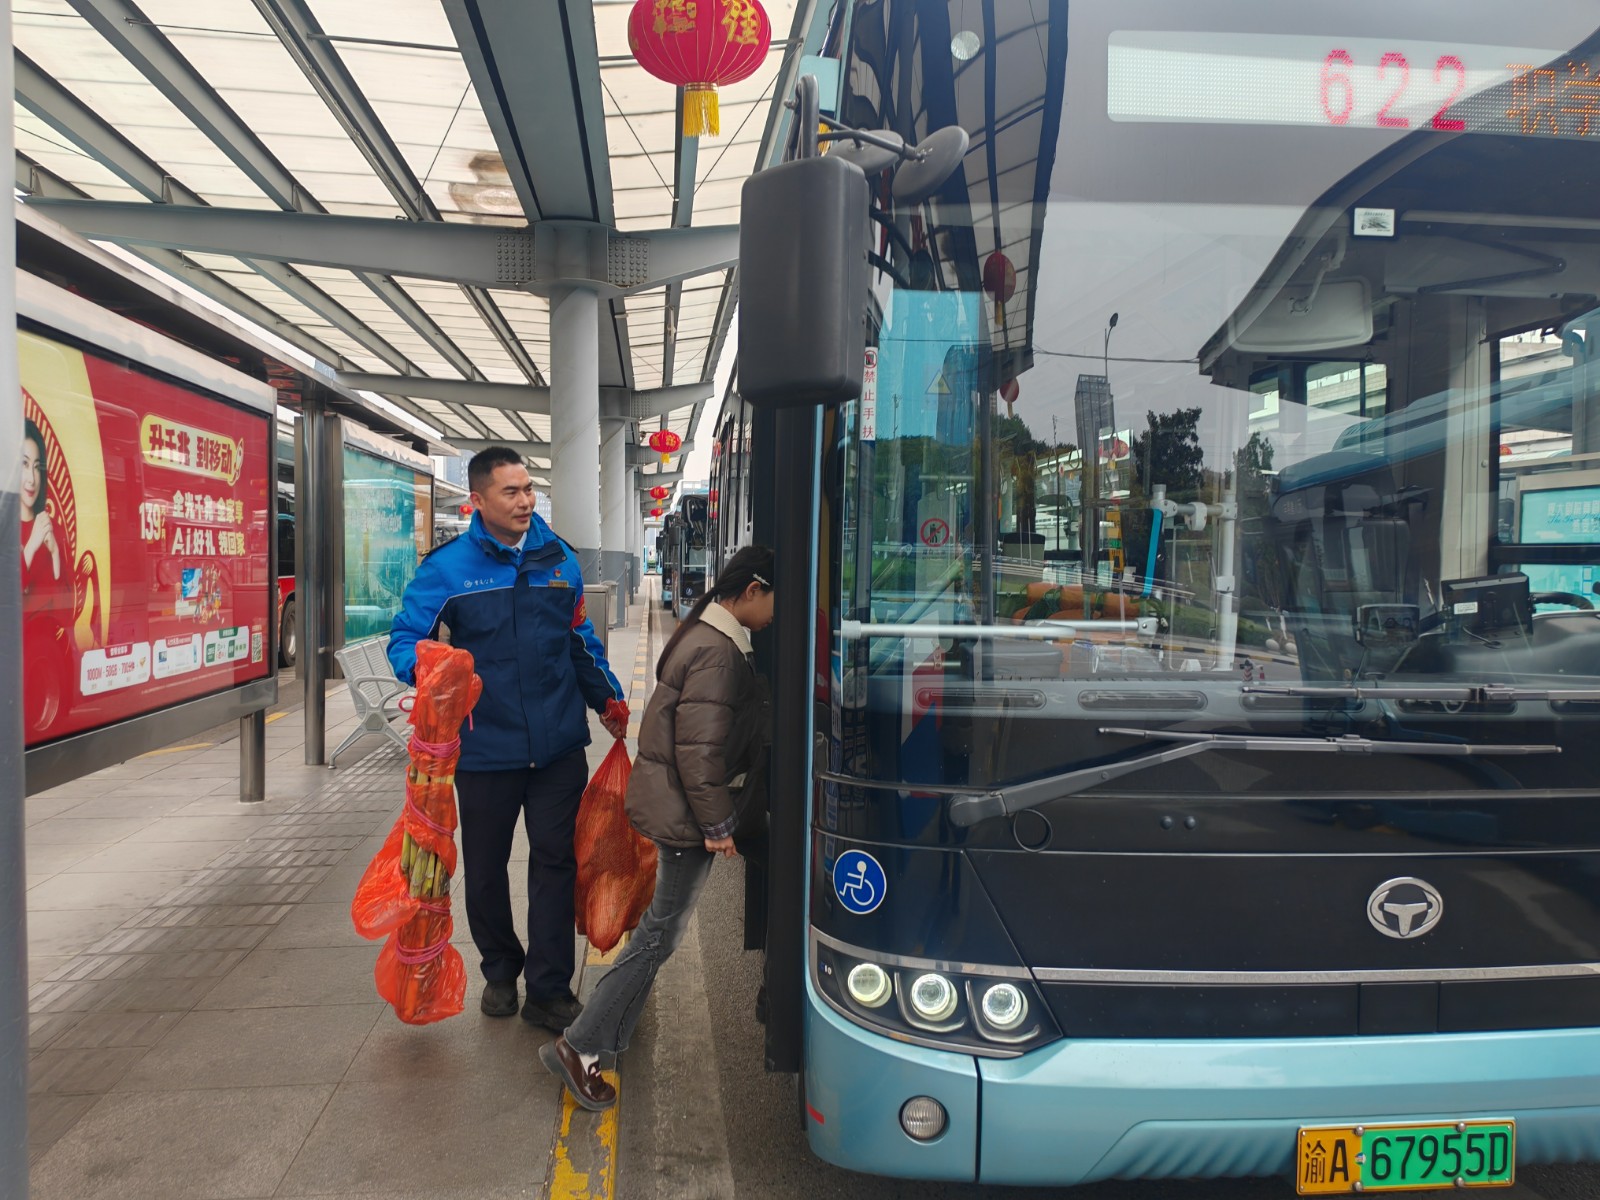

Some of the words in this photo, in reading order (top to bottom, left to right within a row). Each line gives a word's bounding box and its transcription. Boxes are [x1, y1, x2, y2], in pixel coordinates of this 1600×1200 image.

[1319, 48, 1466, 131] 622
[862, 369, 875, 439] 禁止手扶
[149, 423, 191, 467] 升千兆
[196, 435, 233, 476] 到移动
[139, 501, 161, 541] 139
[216, 496, 244, 525] 全家享
[218, 530, 246, 557] 领回家
[1370, 1131, 1509, 1181] 67955D
